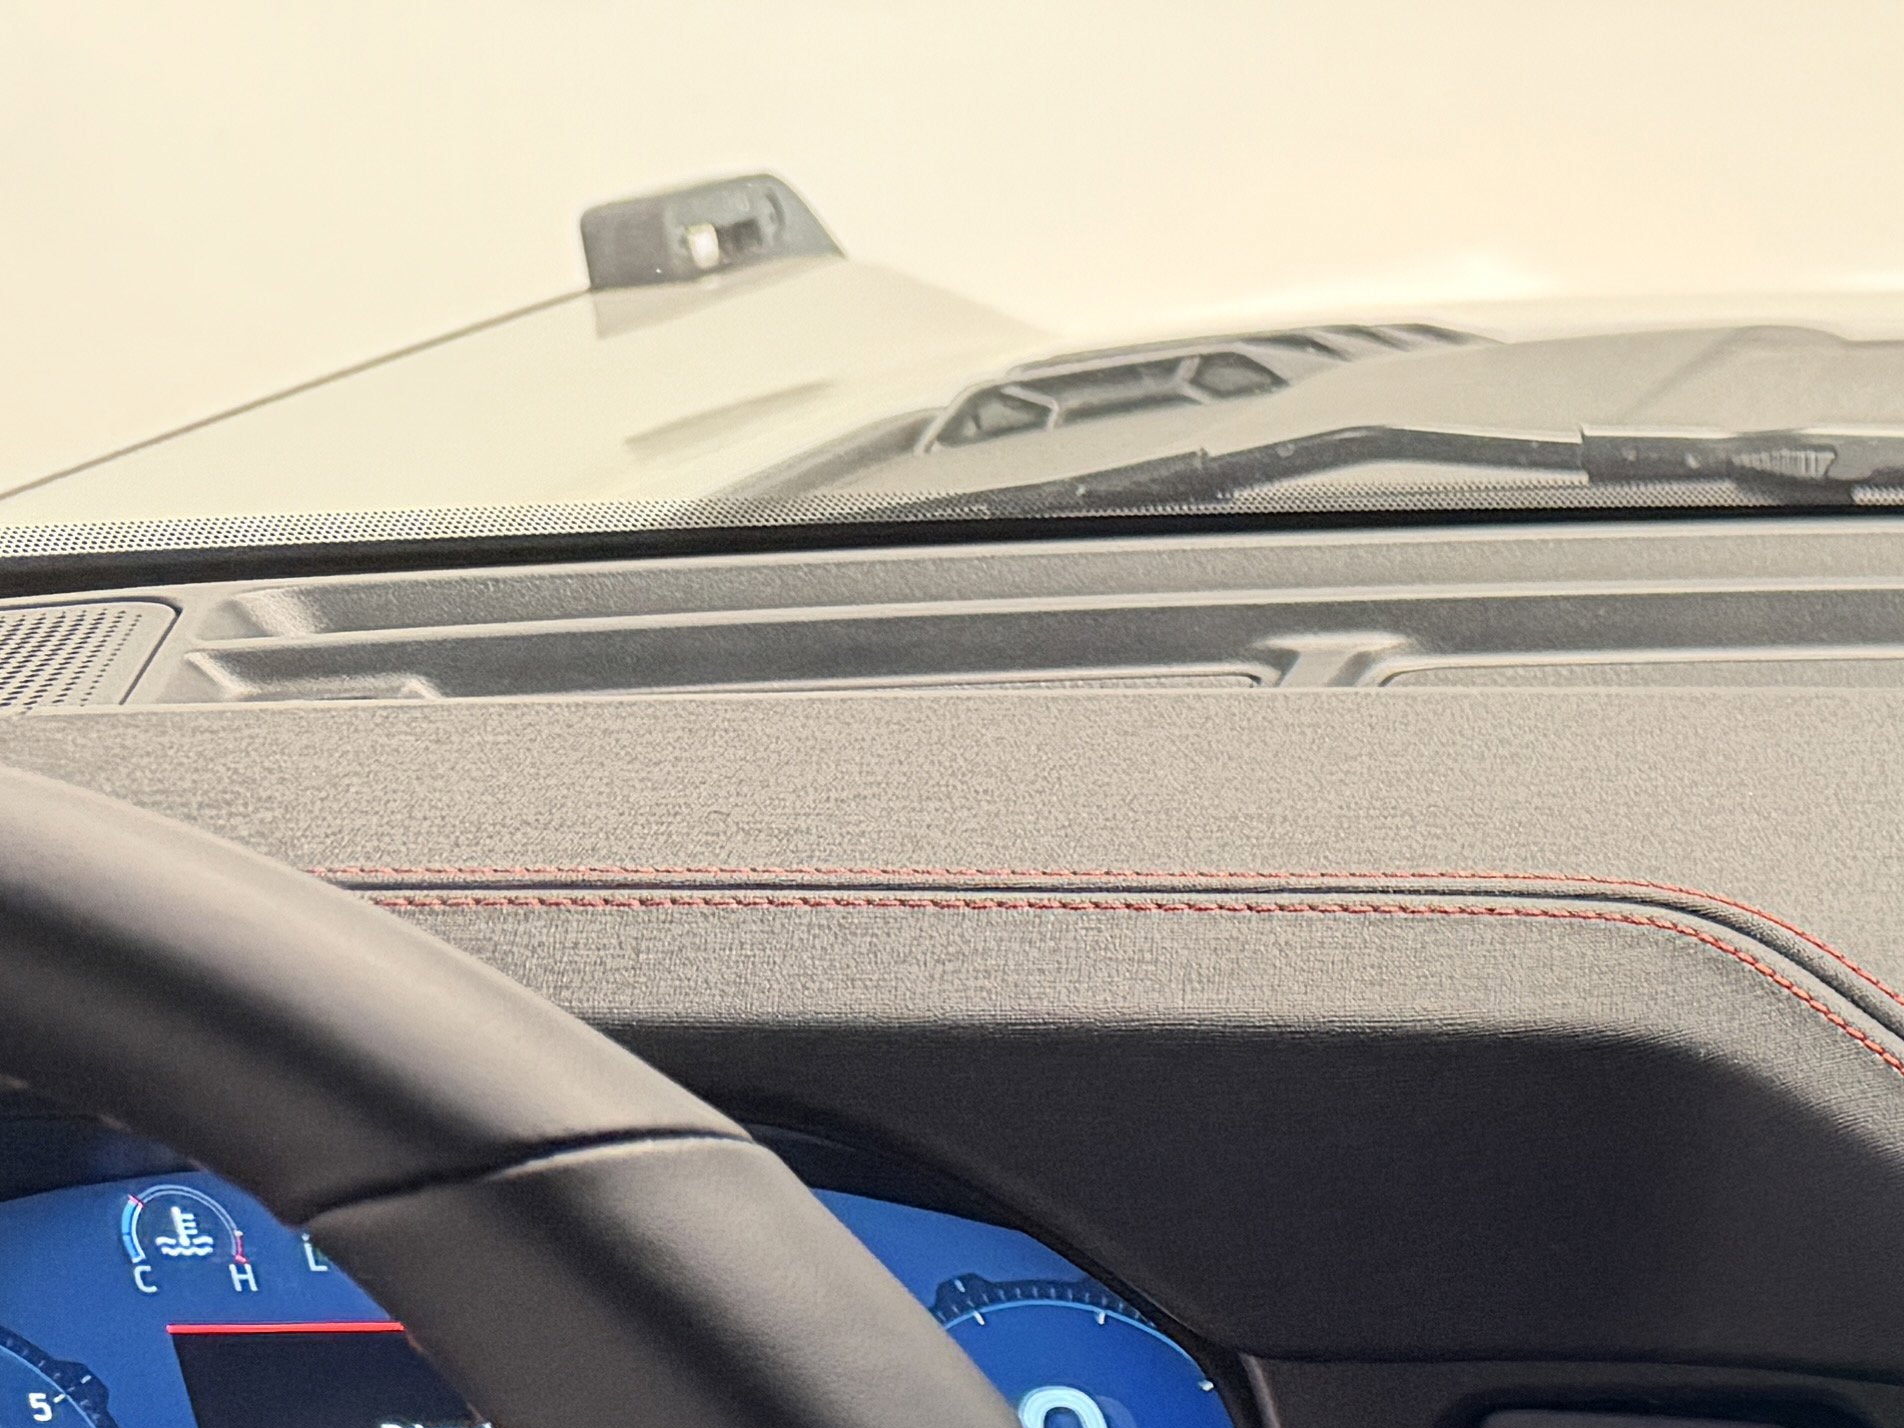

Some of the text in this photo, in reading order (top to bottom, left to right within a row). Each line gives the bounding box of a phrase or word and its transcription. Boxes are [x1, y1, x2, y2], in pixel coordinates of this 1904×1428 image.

[133, 1265, 158, 1293] C
[228, 1263, 259, 1292] H
[28, 1392, 53, 1422] 5
